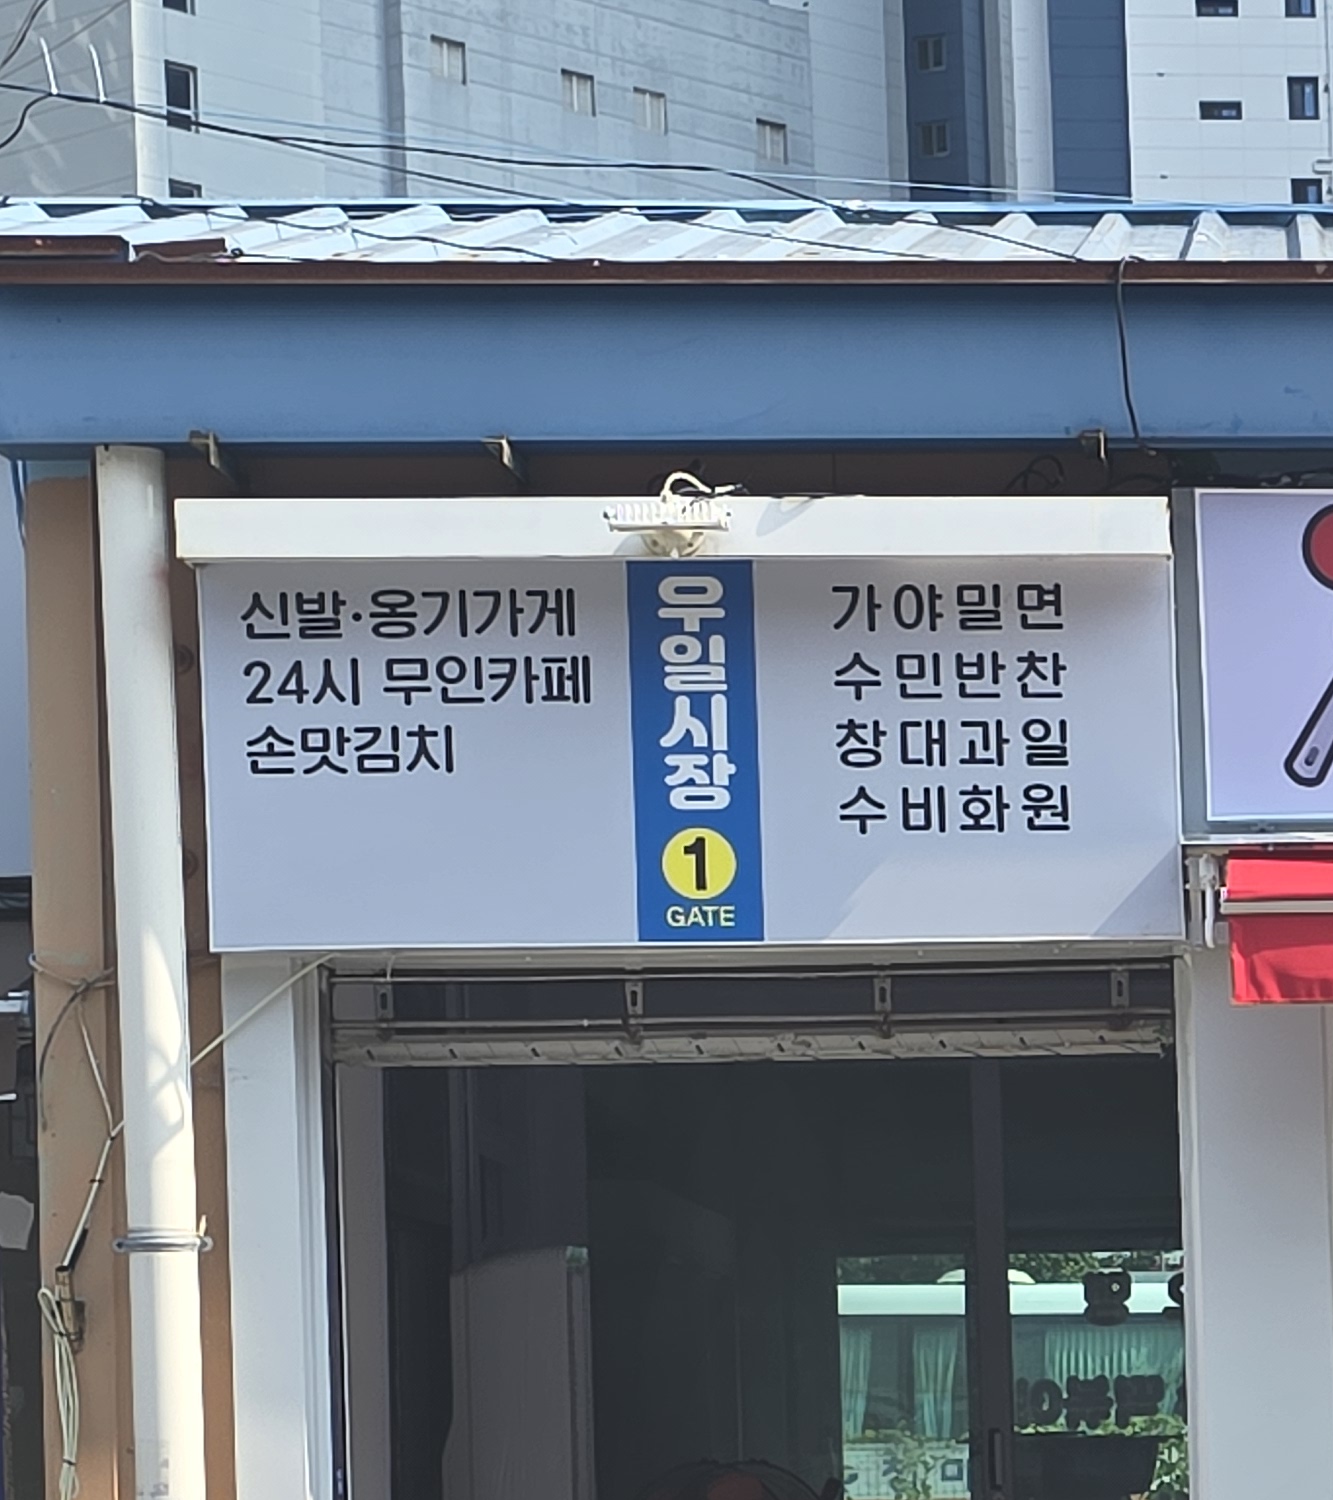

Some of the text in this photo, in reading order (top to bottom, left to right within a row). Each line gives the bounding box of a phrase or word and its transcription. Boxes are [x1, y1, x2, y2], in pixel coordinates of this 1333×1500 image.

[240, 587, 576, 640] 신발·옹기가게
[831, 582, 1064, 632] 가야밀면
[243, 654, 591, 706] 24시 무인카페
[657, 576, 737, 811] 우일시장
[833, 650, 1067, 701] 수민반찬
[246, 724, 454, 775] 손맛김치
[835, 718, 1069, 769] 창대과일
[839, 783, 1071, 835] 수비화원
[683, 836, 708, 892] 1
[666, 905, 735, 927] GATE
